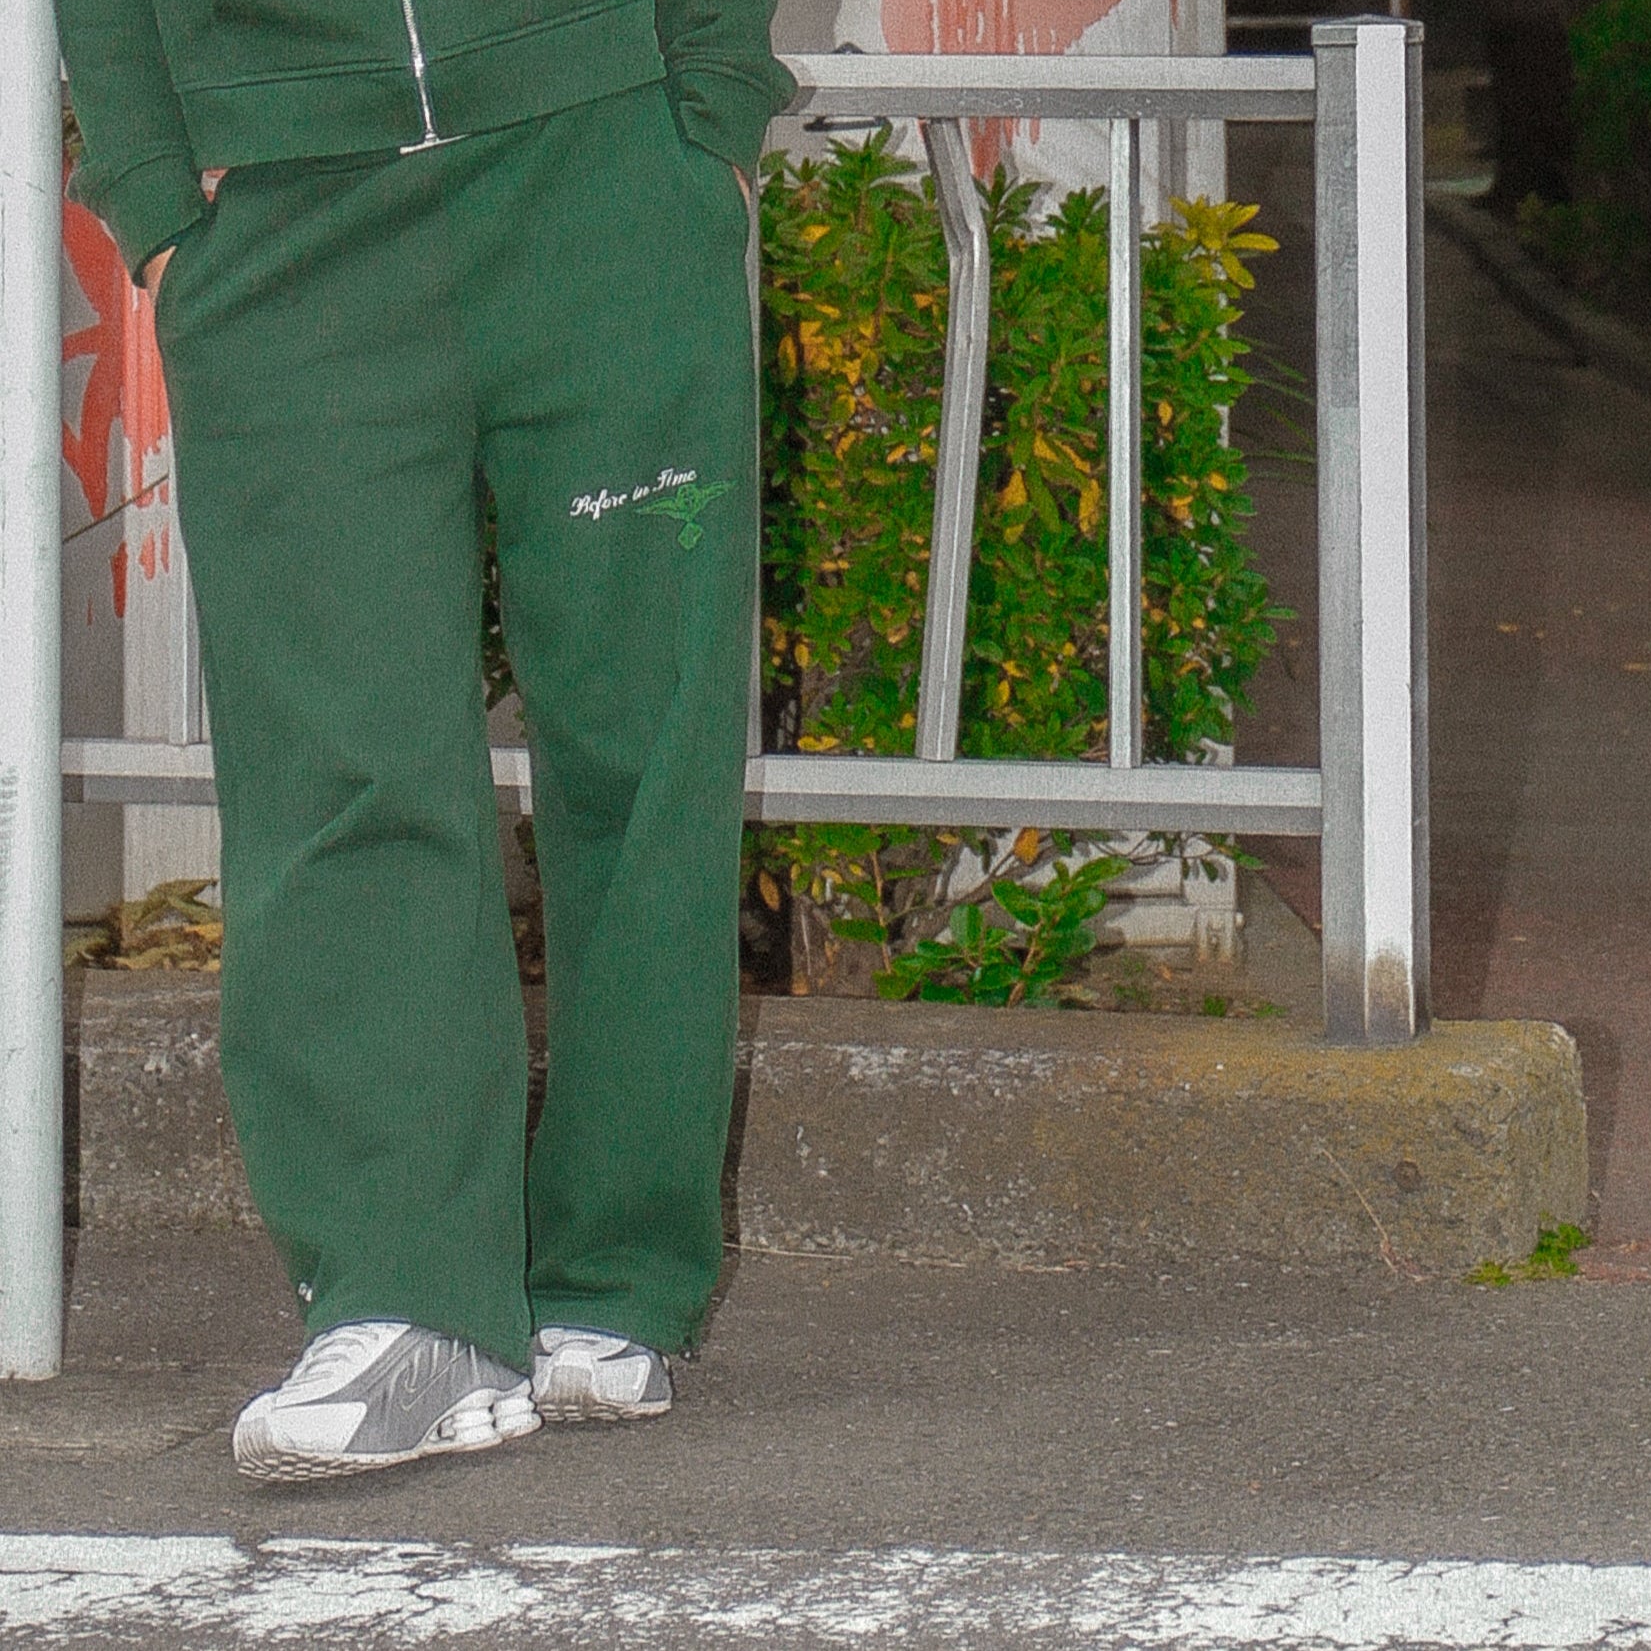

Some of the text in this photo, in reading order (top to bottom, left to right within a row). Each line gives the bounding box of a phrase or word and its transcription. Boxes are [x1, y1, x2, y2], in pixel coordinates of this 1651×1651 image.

[569, 468, 697, 520] Before in Time
